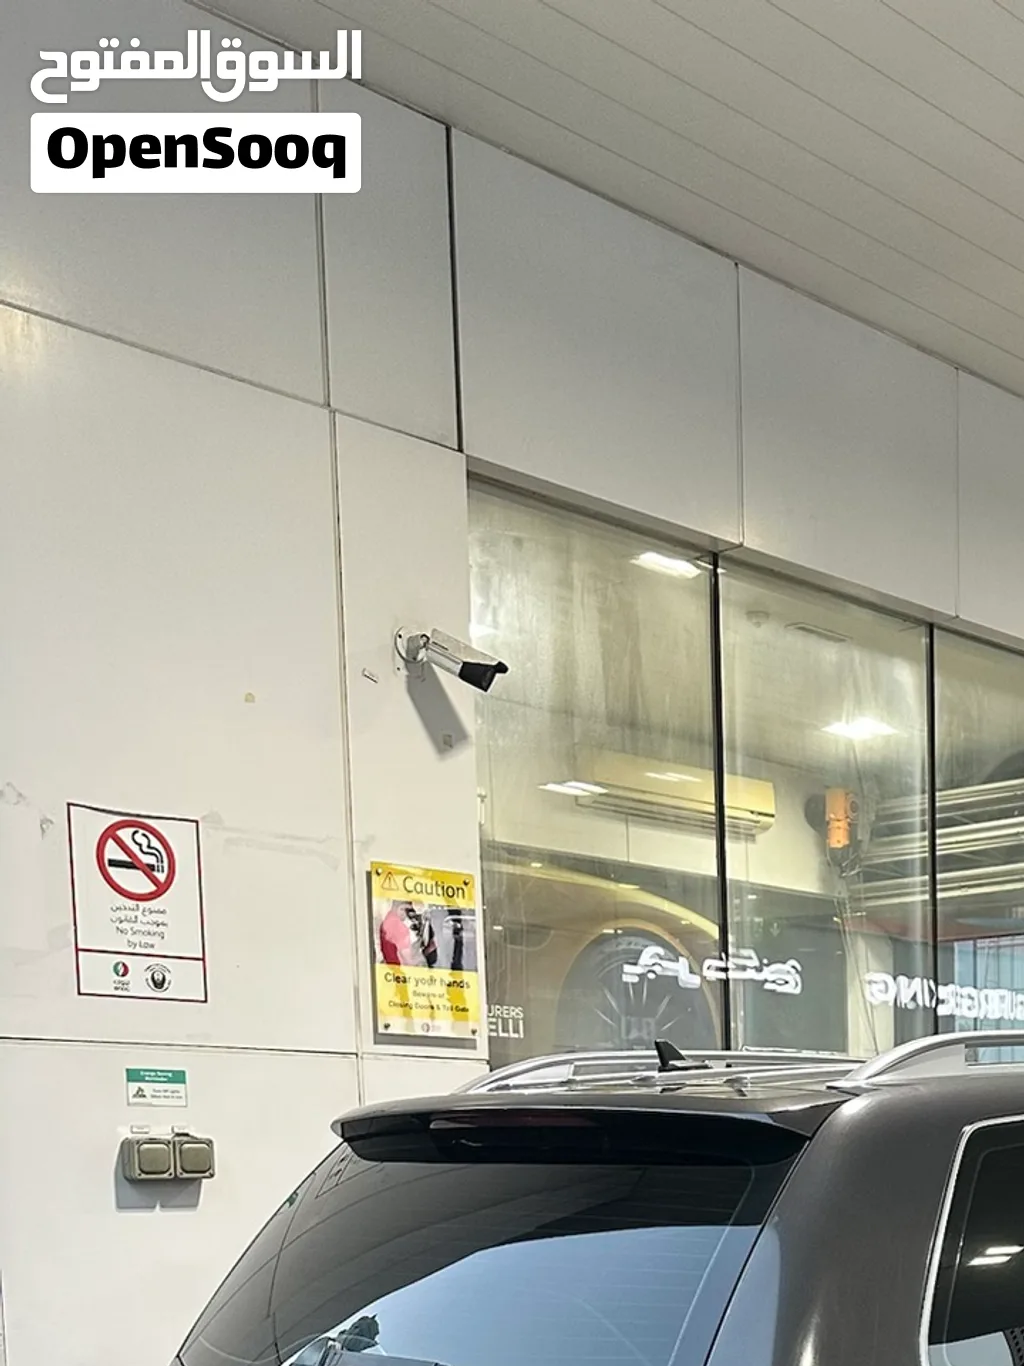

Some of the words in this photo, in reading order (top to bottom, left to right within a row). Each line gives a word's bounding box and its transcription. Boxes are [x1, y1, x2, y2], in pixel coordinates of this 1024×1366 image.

[403, 876, 466, 900] Caution
[116, 926, 129, 936] No
[130, 927, 165, 940] Smoking
[127, 938, 138, 949] by
[384, 972, 411, 984] Clear
[440, 978, 471, 989] hands
